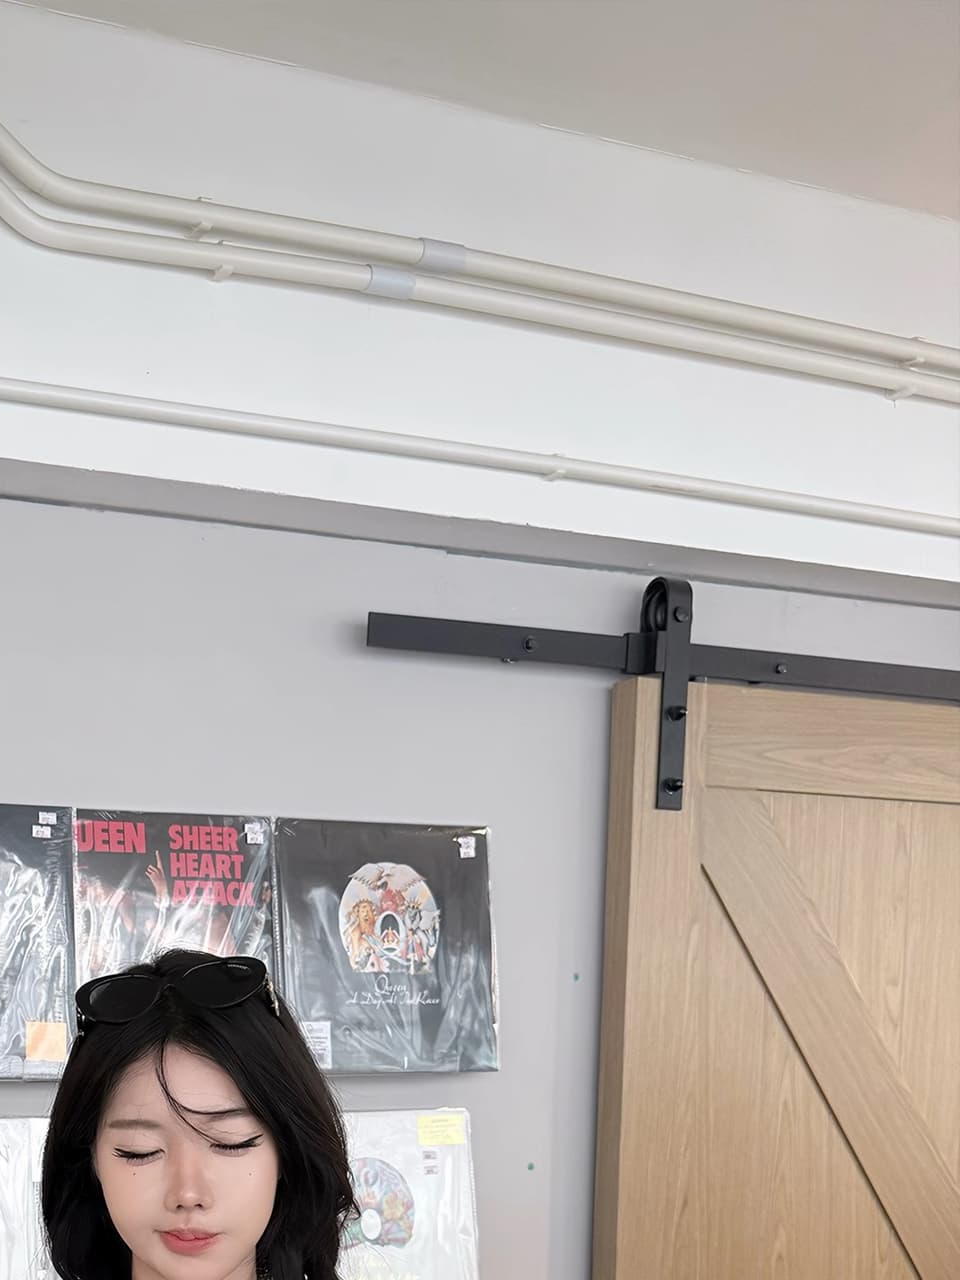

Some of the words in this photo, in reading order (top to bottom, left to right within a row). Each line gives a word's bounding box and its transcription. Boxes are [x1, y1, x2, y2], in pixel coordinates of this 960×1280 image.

[76, 819, 146, 854] UEEN
[168, 823, 239, 852] SHEER
[169, 852, 244, 879] HEART
[172, 878, 255, 907] ATTACK
